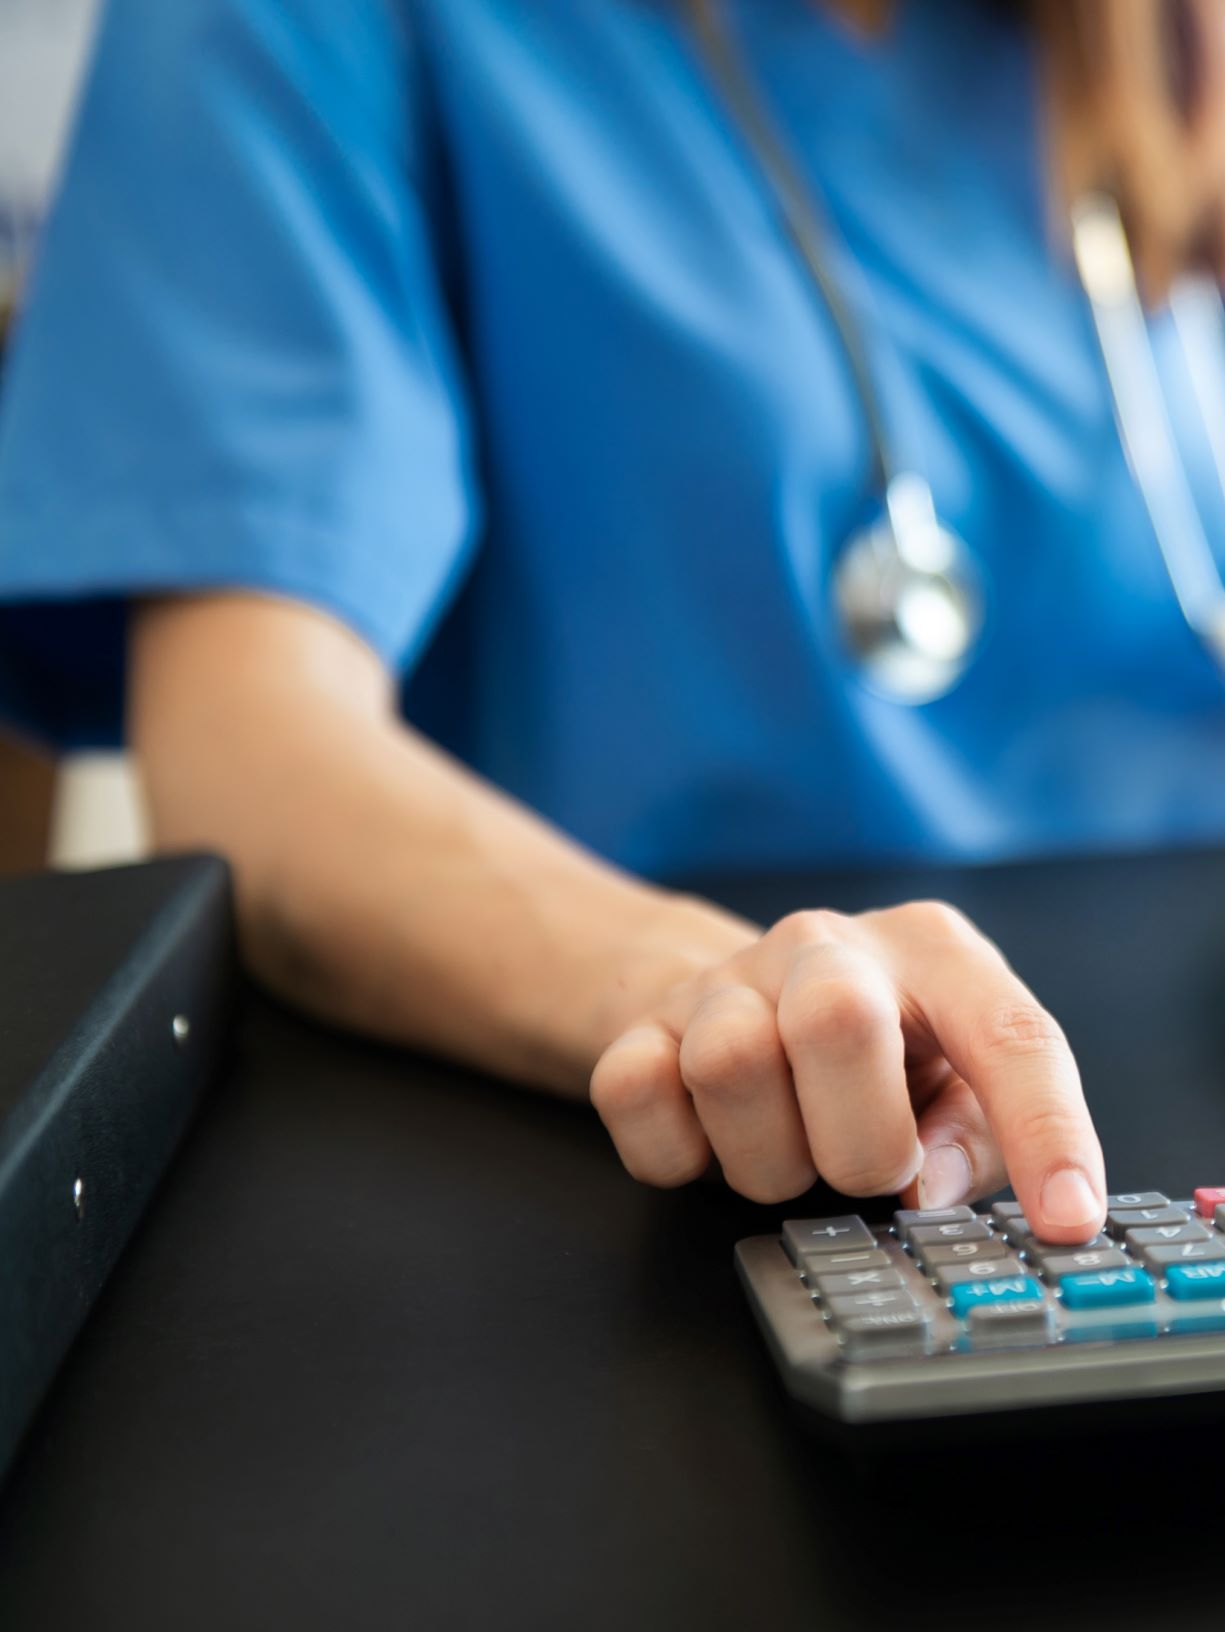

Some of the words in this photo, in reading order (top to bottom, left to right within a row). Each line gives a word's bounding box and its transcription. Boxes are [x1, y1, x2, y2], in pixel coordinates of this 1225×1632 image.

[1116, 1194, 1142, 1204] 0
[1141, 1209, 1159, 1220] 1
[938, 1223, 964, 1237] 3
[1154, 1226, 1182, 1239] 4
[952, 1242, 979, 1256] 6
[1181, 1243, 1205, 1257] 7
[1073, 1253, 1102, 1267] 8
[968, 1262, 997, 1276] 9
[966, 1276, 1027, 1296] M+
